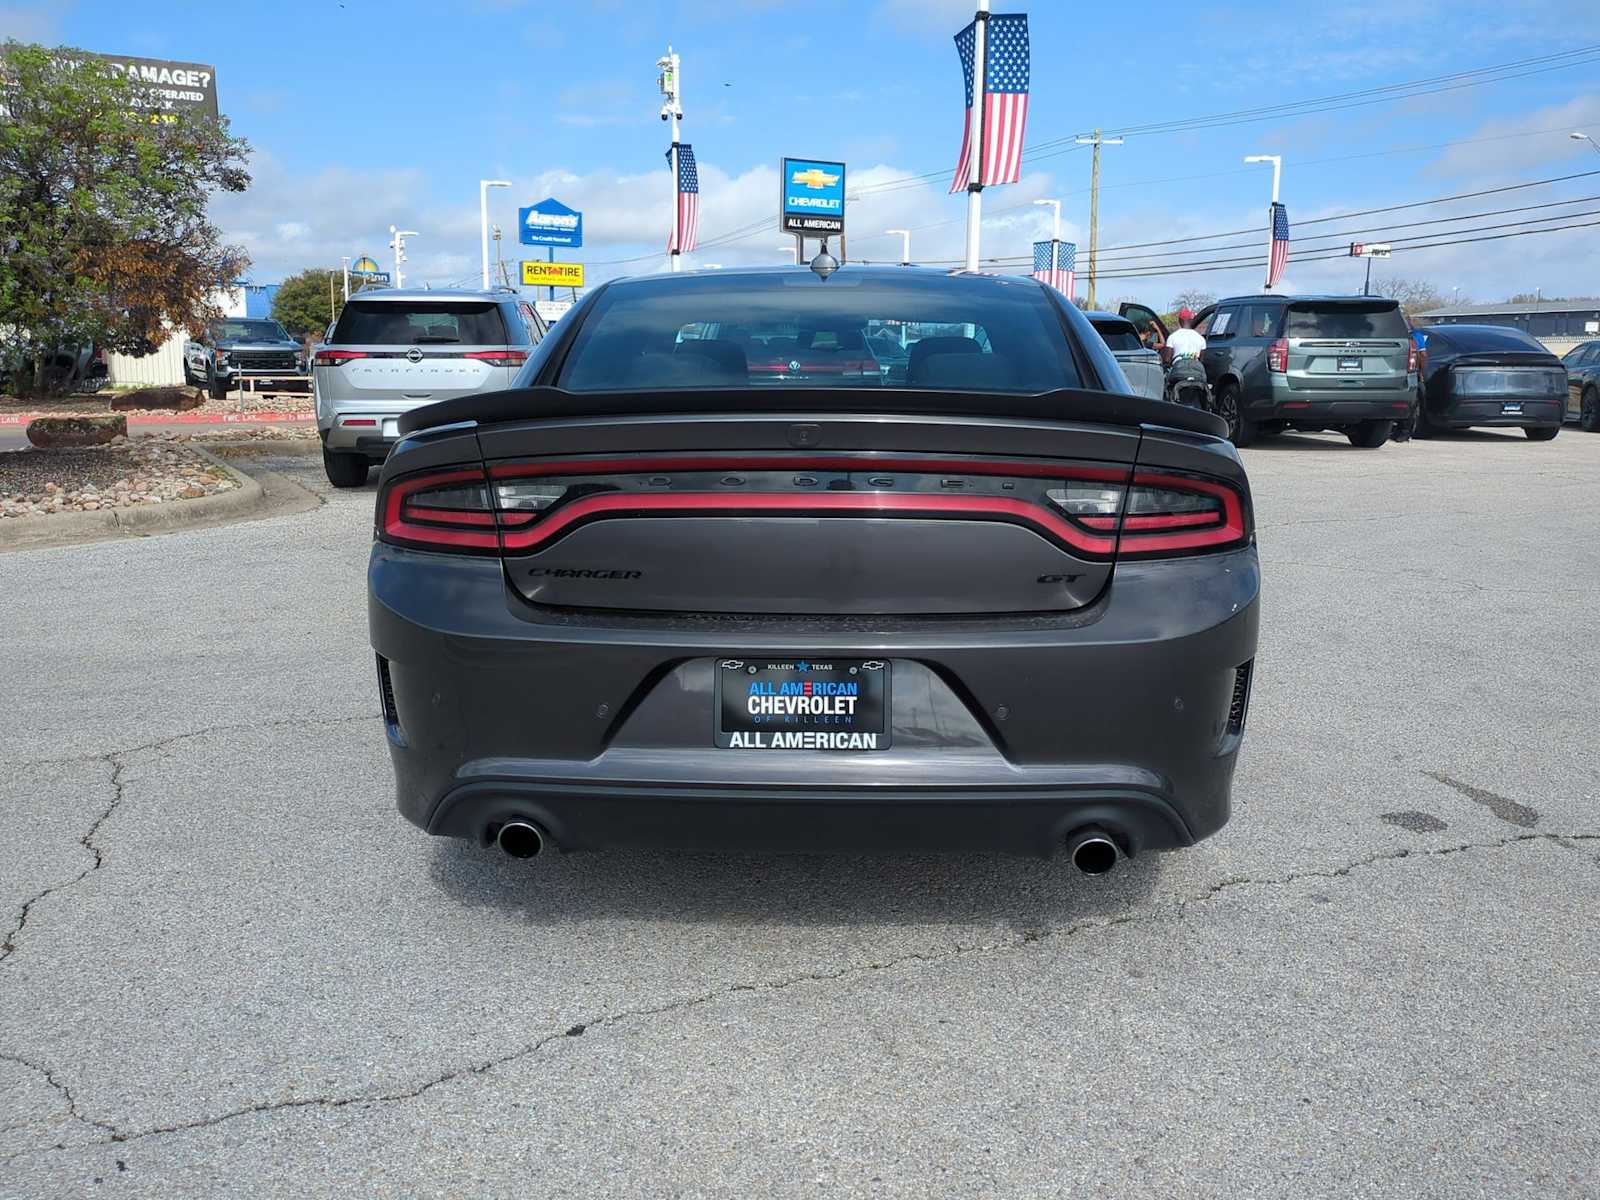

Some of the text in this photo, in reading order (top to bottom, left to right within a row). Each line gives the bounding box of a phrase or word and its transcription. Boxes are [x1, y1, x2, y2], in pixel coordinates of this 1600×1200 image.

[788, 196, 840, 208] CHEVROLET
[788, 218, 841, 229] ALL AMERICAN
[527, 266, 552, 275] RENT
[558, 267, 580, 277] TIRE
[528, 567, 642, 580] CHARGER
[1036, 574, 1087, 584] GT
[749, 681, 857, 696] ALL AMERICAN
[748, 696, 857, 715] CHEVROLET
[784, 716, 852, 724] KILLEEN
[729, 732, 877, 749] ALL AMERICAN
